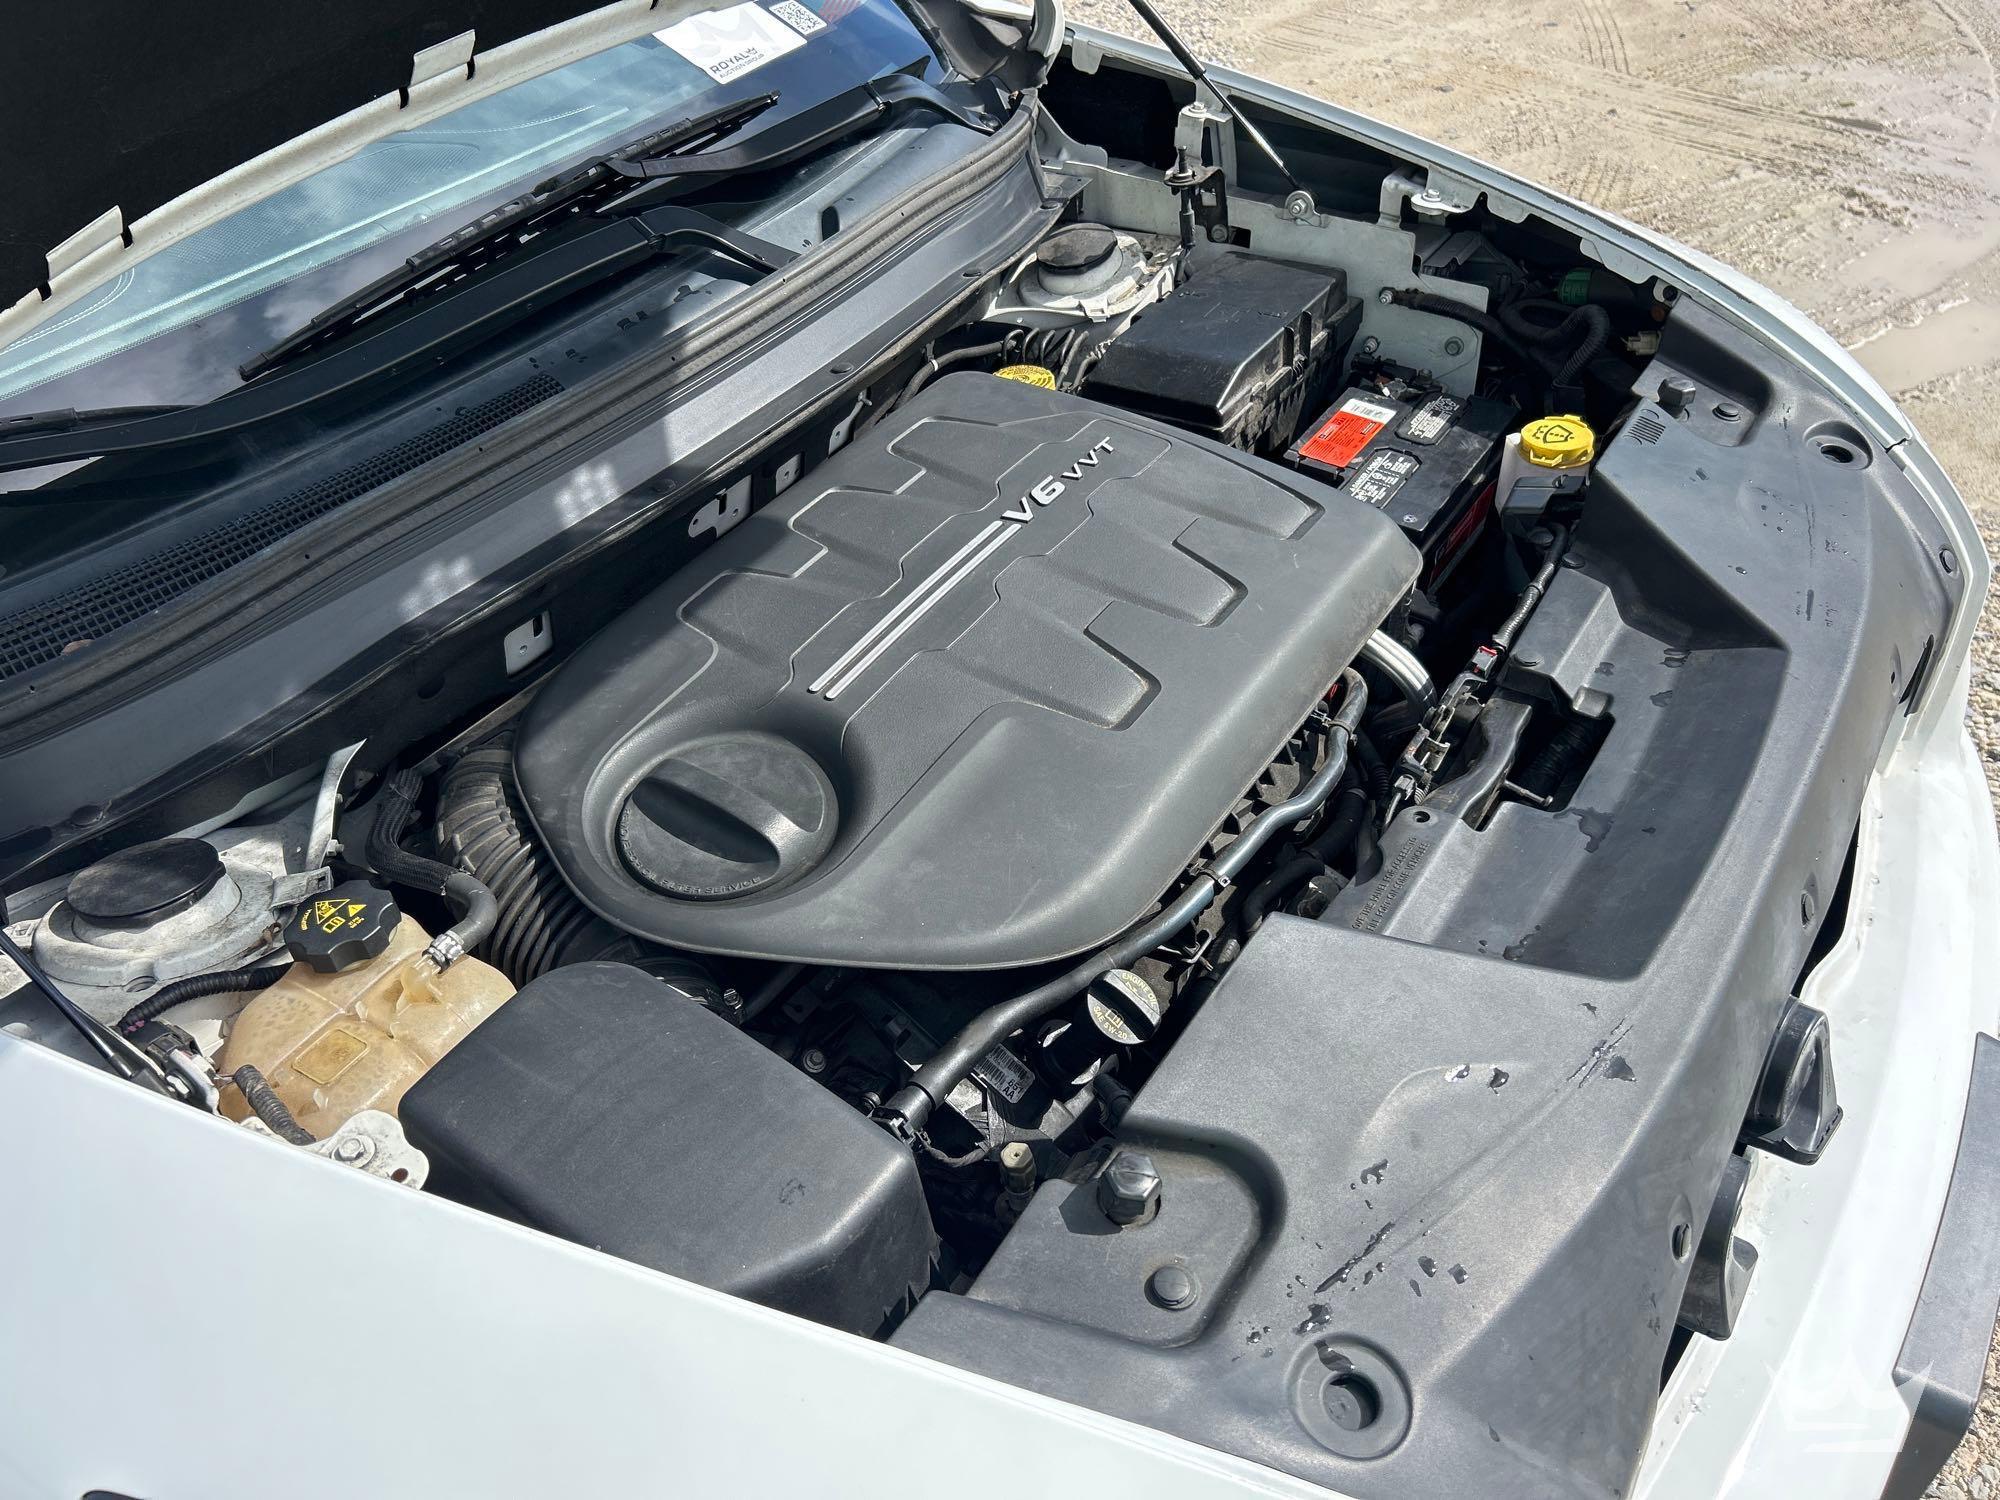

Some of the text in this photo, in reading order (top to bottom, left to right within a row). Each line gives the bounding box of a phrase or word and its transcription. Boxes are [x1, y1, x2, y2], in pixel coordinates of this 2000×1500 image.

[709, 52, 750, 74] ROYAL
[1000, 436, 1114, 524] V6 VVT
[660, 879, 701, 895] FILTER
[704, 875, 761, 895] SERVICE
[1121, 972, 1162, 1010] ENGINE OIL
[1093, 1004, 1128, 1040] SAE 5W-20
[1002, 1086, 1015, 1100] AA
